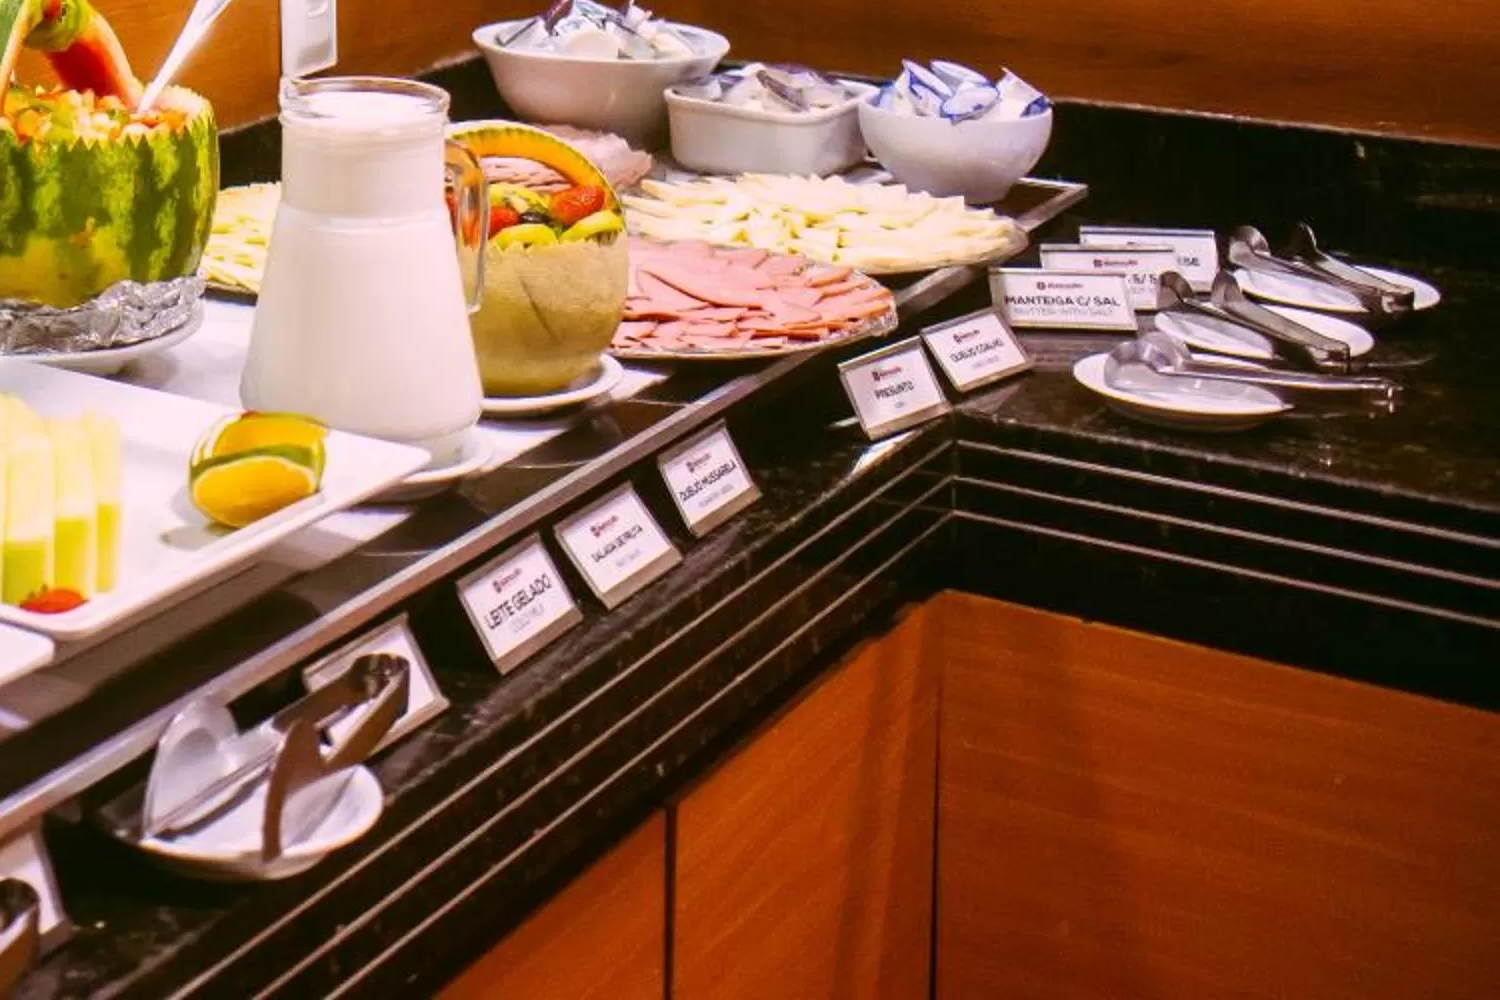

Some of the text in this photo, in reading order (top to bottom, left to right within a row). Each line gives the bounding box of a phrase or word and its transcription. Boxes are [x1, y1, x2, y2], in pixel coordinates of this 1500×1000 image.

[1003, 295, 1121, 307] MANTEIGA C/ SAL
[485, 601, 515, 630] LEITE
[512, 573, 552, 610] GELADO
